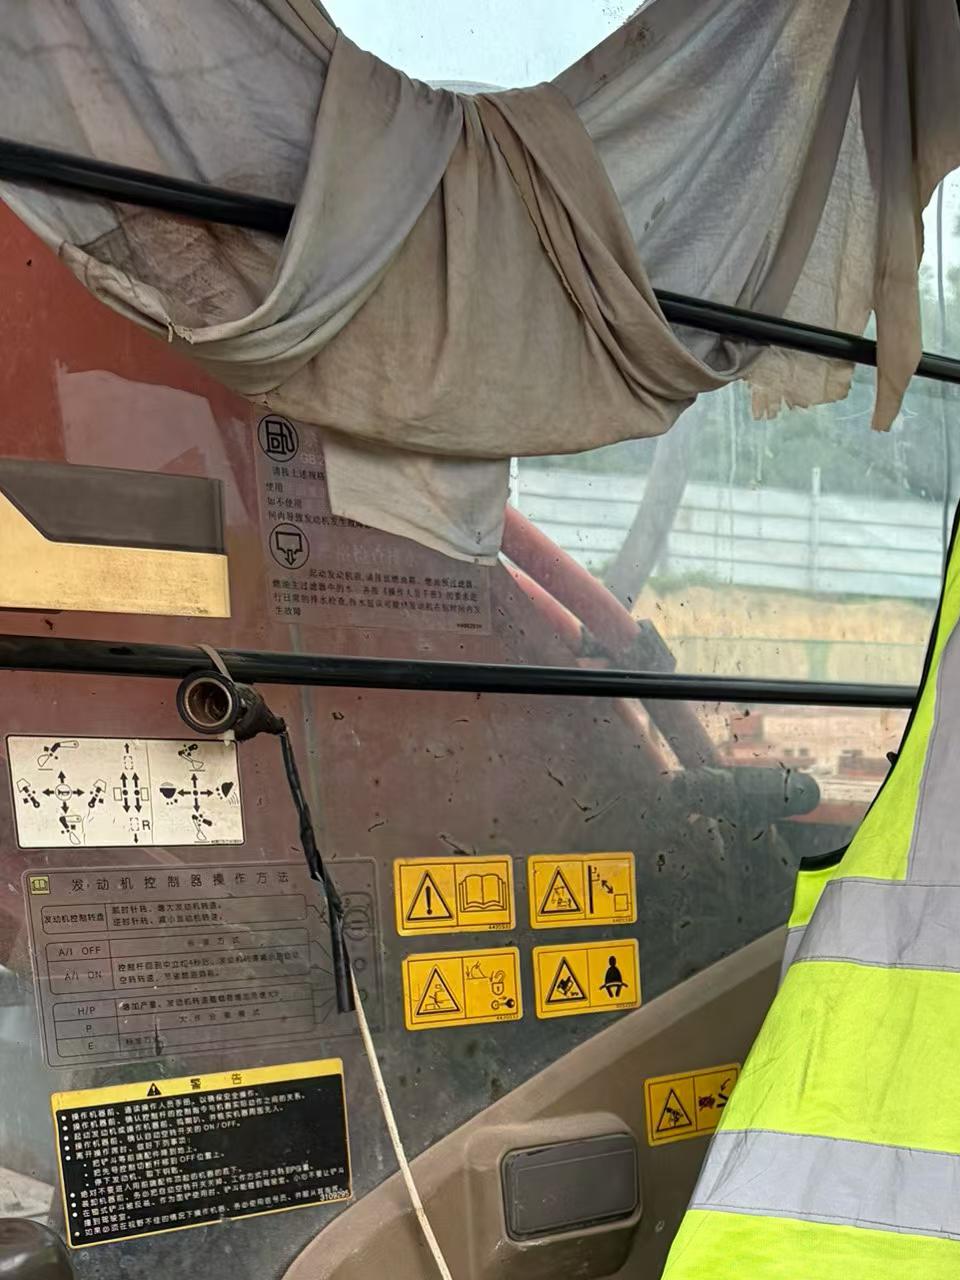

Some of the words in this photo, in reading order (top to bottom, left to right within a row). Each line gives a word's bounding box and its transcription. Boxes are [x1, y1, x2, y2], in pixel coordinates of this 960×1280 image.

[142, 820, 151, 831] R
[71, 872, 289, 892] 发动机控制器操作方法
[81, 946, 101, 956] OFF
[87, 970, 102, 980] ON
[78, 1006, 95, 1016] H/P
[86, 1024, 92, 1033] P
[88, 1041, 94, 1050] E
[190, 1073, 242, 1090] 警告
